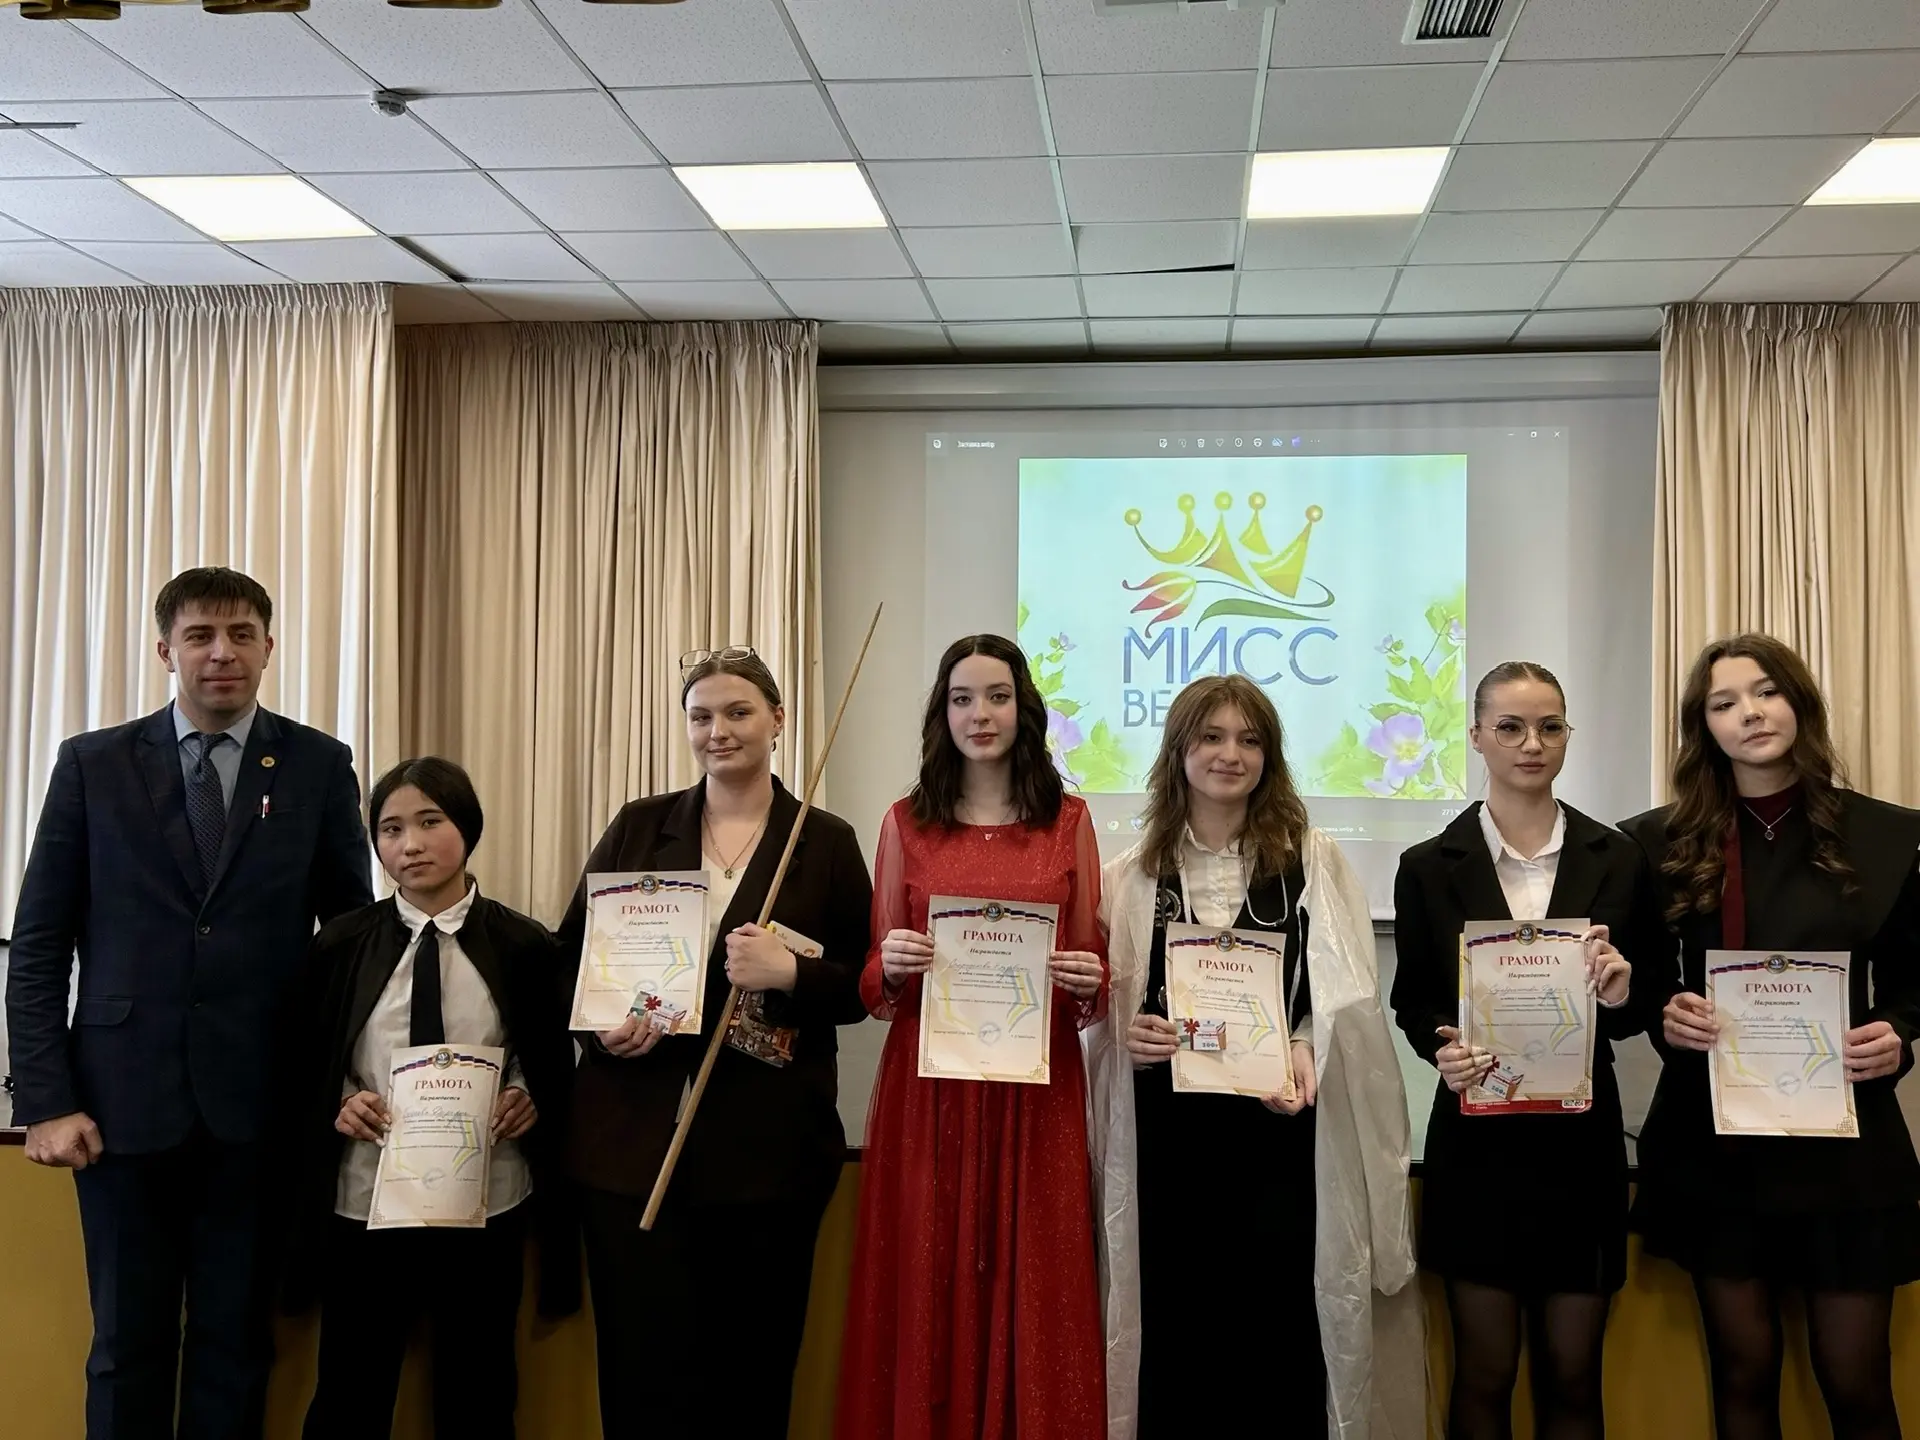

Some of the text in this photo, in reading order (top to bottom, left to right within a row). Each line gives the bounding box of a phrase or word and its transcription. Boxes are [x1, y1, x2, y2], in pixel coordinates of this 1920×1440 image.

[1123, 626, 1339, 686] МИСС
[621, 903, 680, 915] ГРАМОТА
[963, 930, 1024, 943] ГРАМОТА
[1198, 959, 1254, 974] ГРАМОТА
[1500, 955, 1561, 966] ГРАМОТА
[1744, 983, 1812, 993] ГРАМОТА
[414, 1078, 472, 1090] ГРАМОТА
